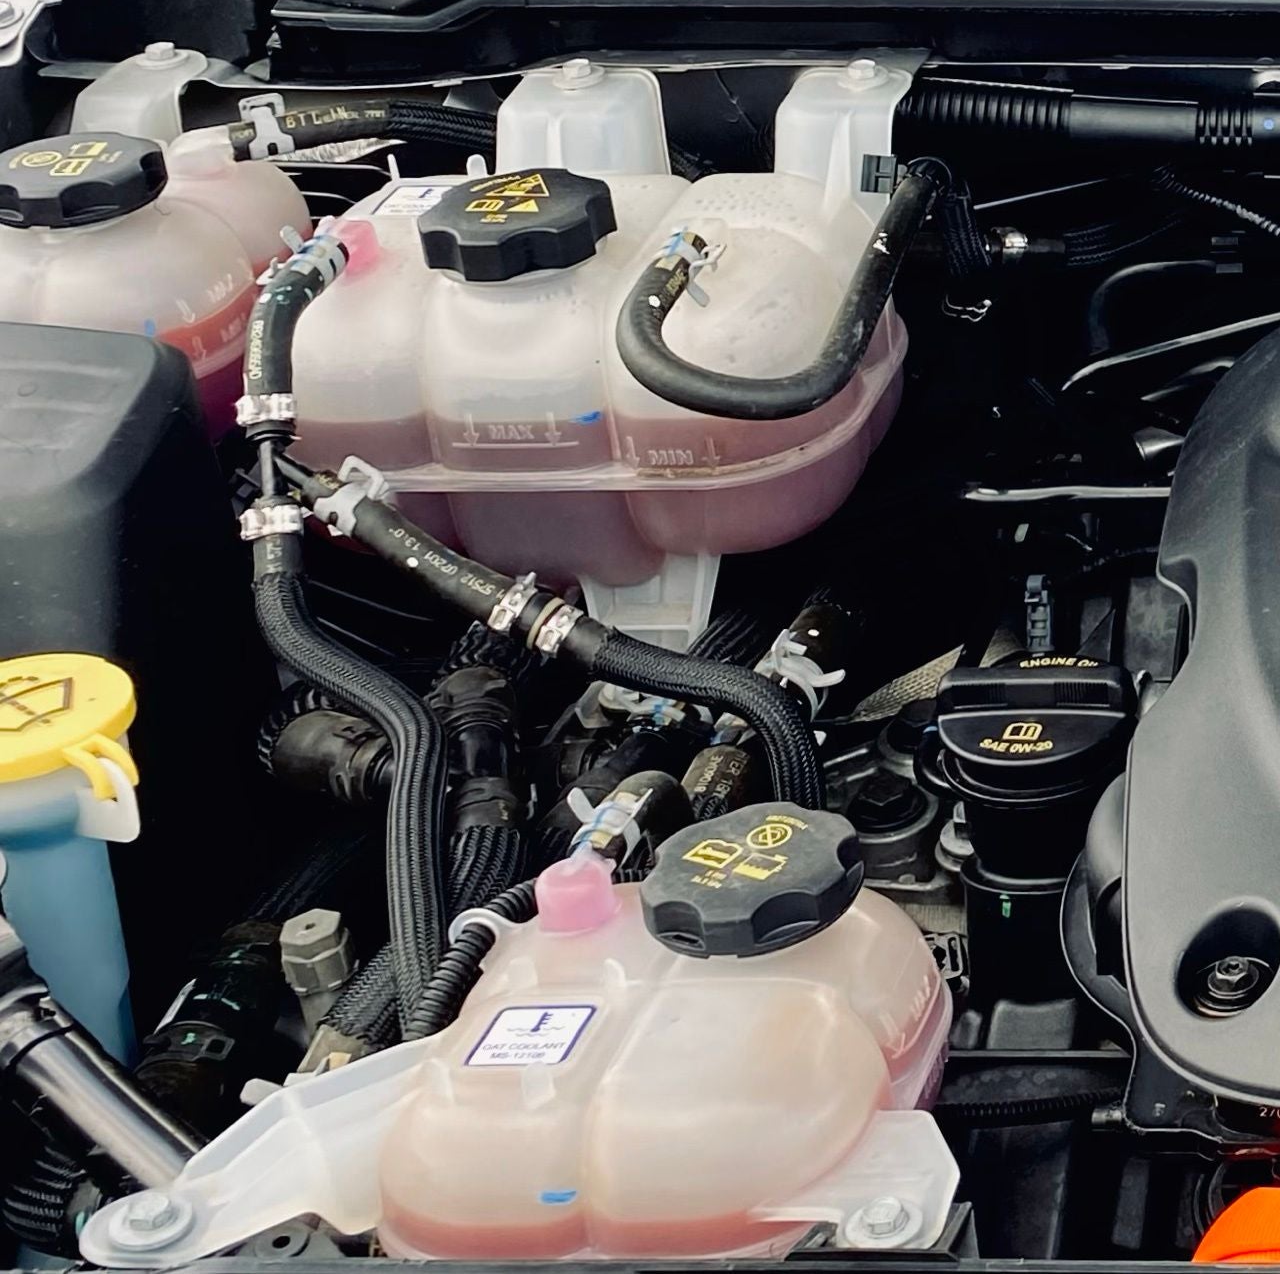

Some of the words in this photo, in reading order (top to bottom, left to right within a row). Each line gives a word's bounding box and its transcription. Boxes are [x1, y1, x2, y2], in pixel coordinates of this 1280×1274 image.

[487, 424, 535, 441] MAX
[648, 448, 695, 466] MIN
[1019, 656, 1077, 669] ENGINE
[979, 737, 1009, 752] SAE
[1009, 740, 1054, 754] 0W-20
[508, 1041, 566, 1051] COOLANT
